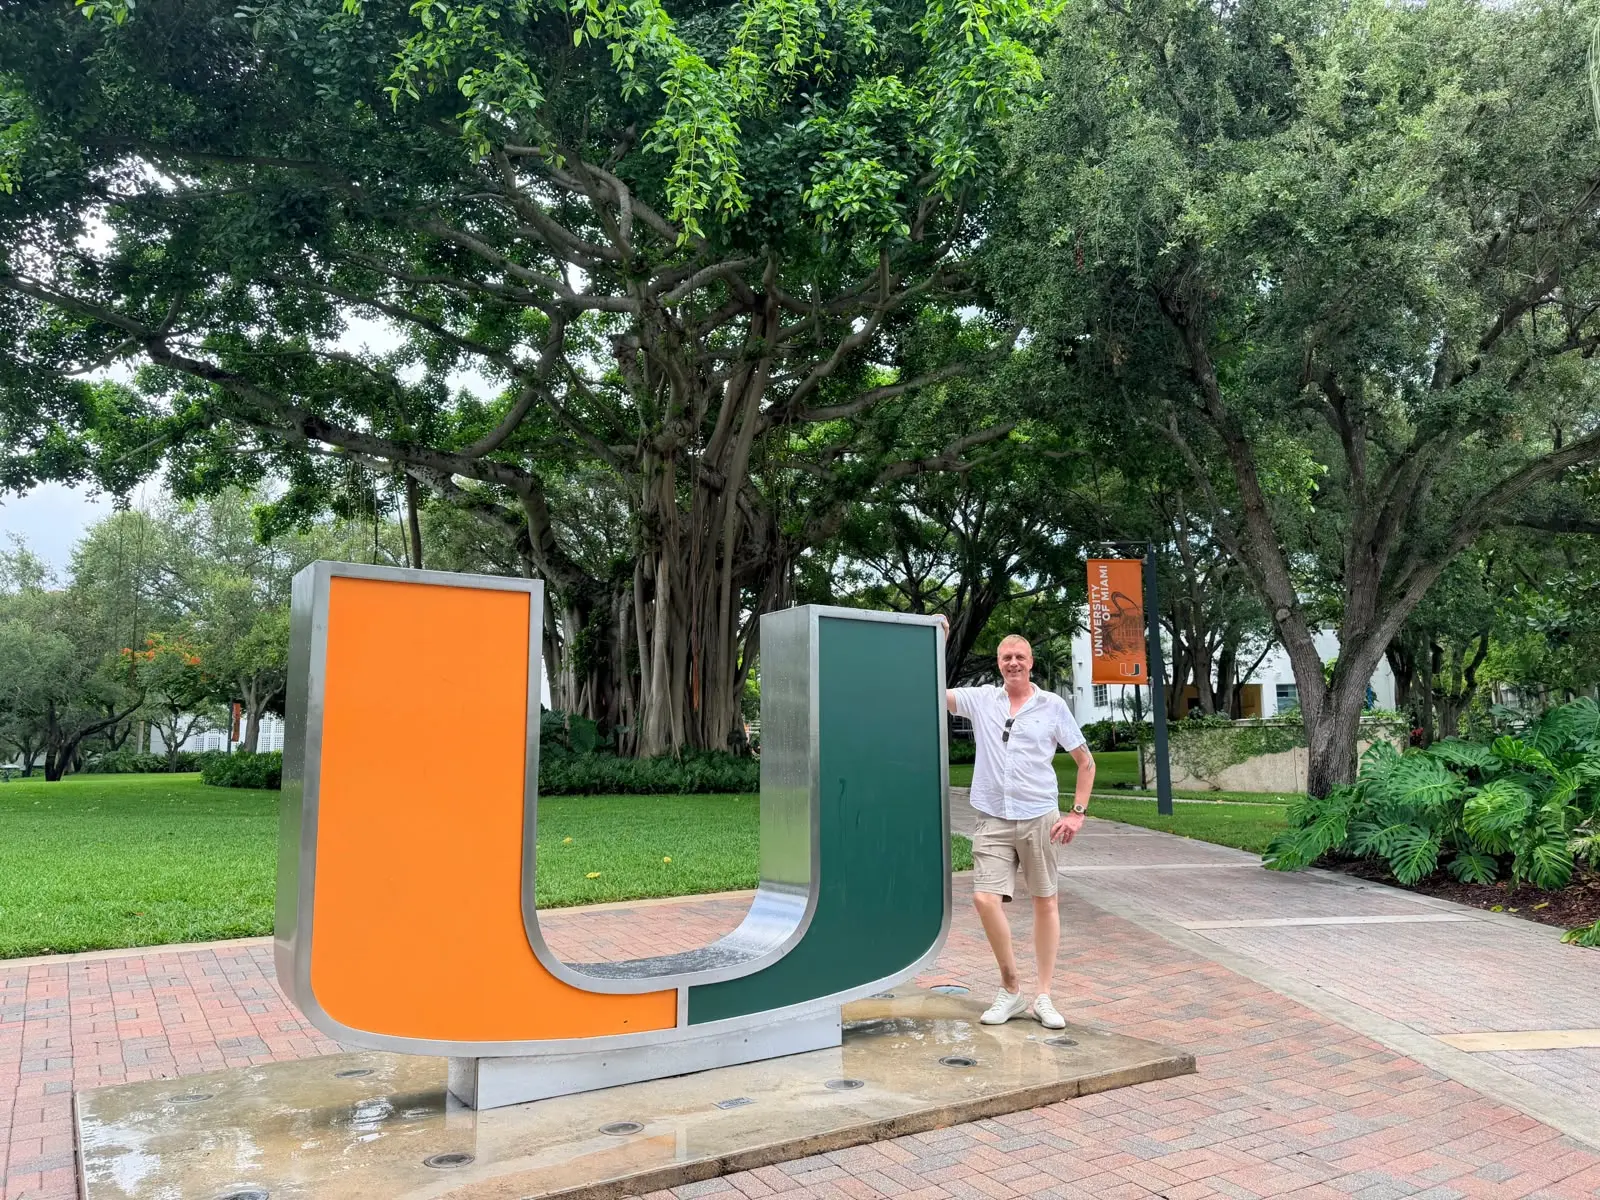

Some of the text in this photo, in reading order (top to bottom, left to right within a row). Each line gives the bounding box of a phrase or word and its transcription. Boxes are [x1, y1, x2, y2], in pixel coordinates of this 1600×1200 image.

[1091, 584, 1104, 657] UNIVERSITY
[1099, 565, 1111, 621] OF MIAMI
[1120, 663, 1140, 676] U
[275, 560, 951, 1056] U
